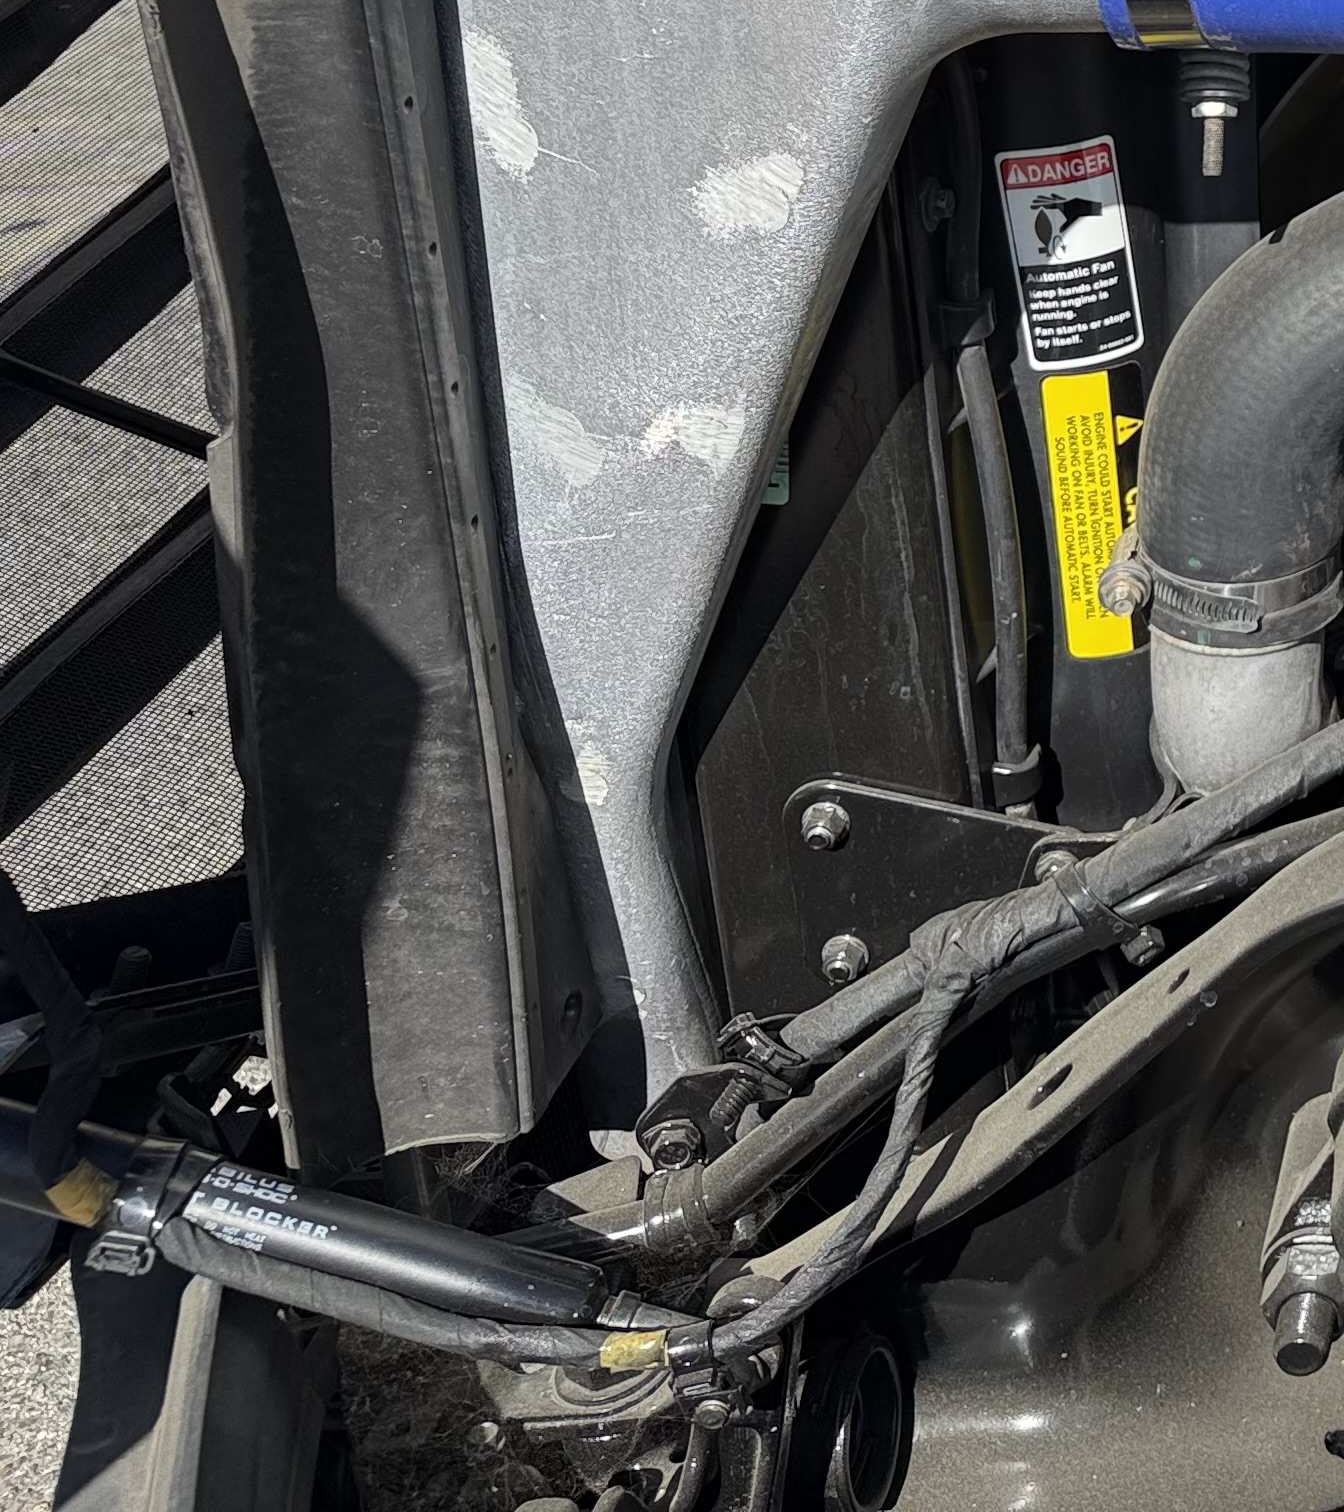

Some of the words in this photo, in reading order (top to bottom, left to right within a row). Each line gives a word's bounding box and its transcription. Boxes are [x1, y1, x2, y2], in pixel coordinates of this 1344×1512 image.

[1028, 151, 1110, 183] DANGER
[1026, 267, 1090, 283] Automatic
[1092, 260, 1115, 274] Fan
[1029, 289, 1056, 299] Keep
[1058, 283, 1091, 297] hands
[1093, 276, 1119, 290] clear
[1030, 300, 1059, 310] when
[1060, 294, 1097, 308] engine
[1099, 291, 1109, 300] is
[1032, 310, 1077, 321] running.
[1034, 327, 1054, 336] Fan
[1056, 323, 1088, 335] starts
[1089, 320, 1102, 330] or
[1103, 310, 1131, 326] stops
[1036, 338, 1051, 349] by
[1052, 334, 1083, 347] itself.
[1066, 415, 1081, 468] WORKING
[1080, 415, 1092, 446] AVOID
[1094, 412, 1107, 450] ENGINE
[1055, 437, 1067, 473] SOUND
[1084, 450, 1096, 487] INJURY,
[1072, 470, 1082, 487] ON
[1098, 453, 1110, 487] COULD
[1059, 477, 1072, 513] BEFORE
[1074, 490, 1084, 510] FAN
[1088, 489, 1099, 516] TURN
[1101, 490, 1113, 518] START
[1076, 513, 1087, 527] OR
[1064, 516, 1078, 573] AUTOMATIC
[1078, 530, 1089, 559] BELTS.
[1090, 517, 1104, 565] IGNITION
[1081, 561, 1093, 596] ALARM
[1085, 597, 1096, 620] WILL
[212, 1197, 329, 1239] BLOCKER
